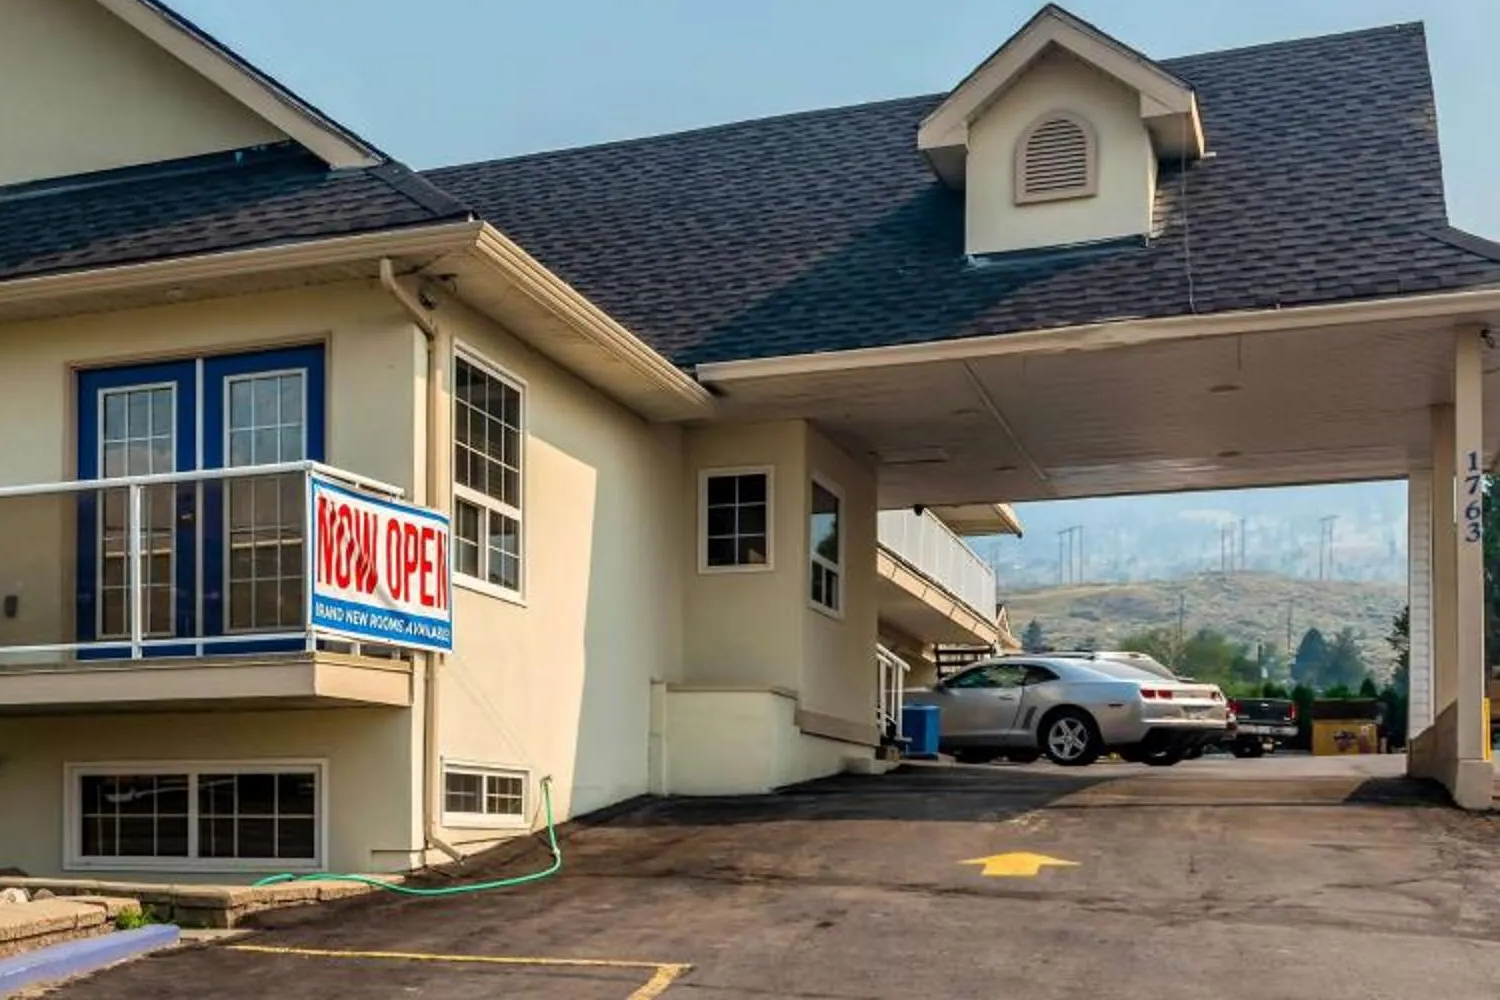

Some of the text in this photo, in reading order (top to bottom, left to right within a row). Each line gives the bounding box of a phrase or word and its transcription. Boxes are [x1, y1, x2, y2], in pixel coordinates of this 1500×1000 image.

[1464, 451, 1482, 543] 1763
[316, 494, 447, 611] NOW OPEN
[345, 608, 369, 628] NEW
[369, 613, 405, 633] ROOMS
